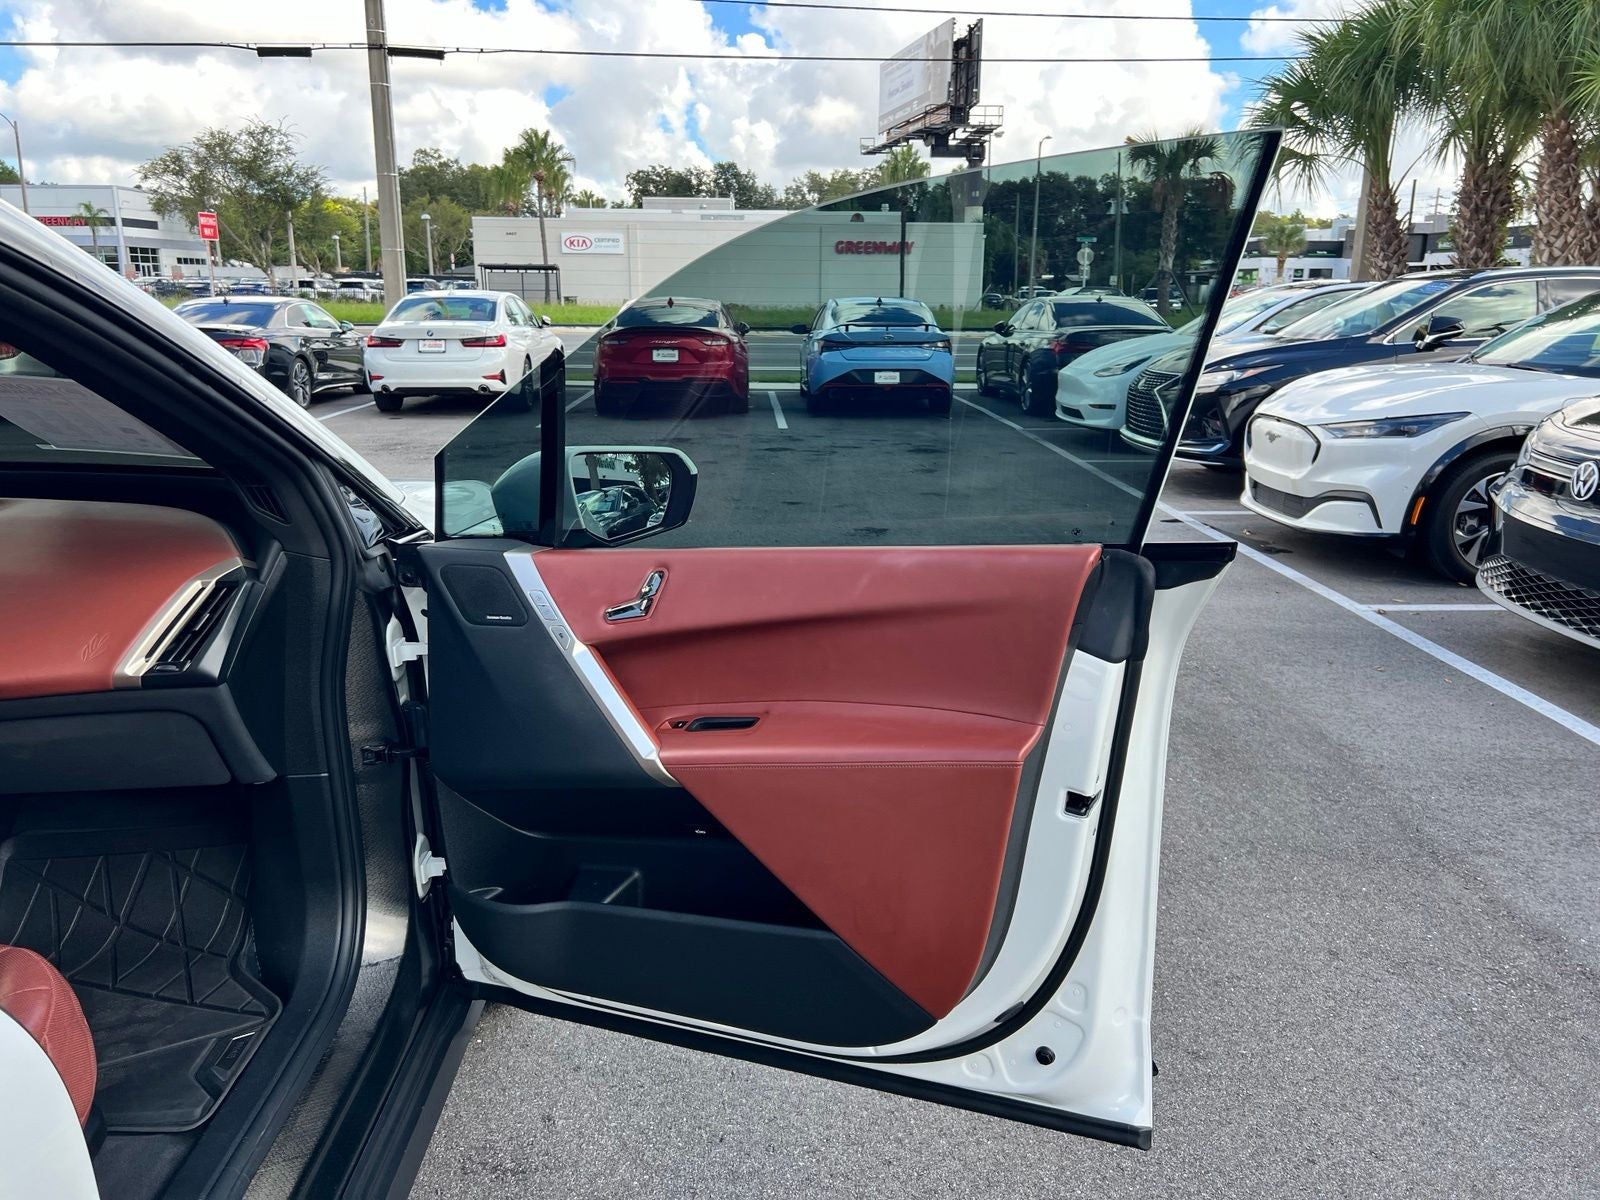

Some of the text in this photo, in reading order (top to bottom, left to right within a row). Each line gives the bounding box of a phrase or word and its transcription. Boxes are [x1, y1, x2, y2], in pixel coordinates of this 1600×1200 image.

[37, 217, 86, 227] REENWAY
[203, 227, 215, 237] WAY
[835, 240, 915, 255] GREENWAY
